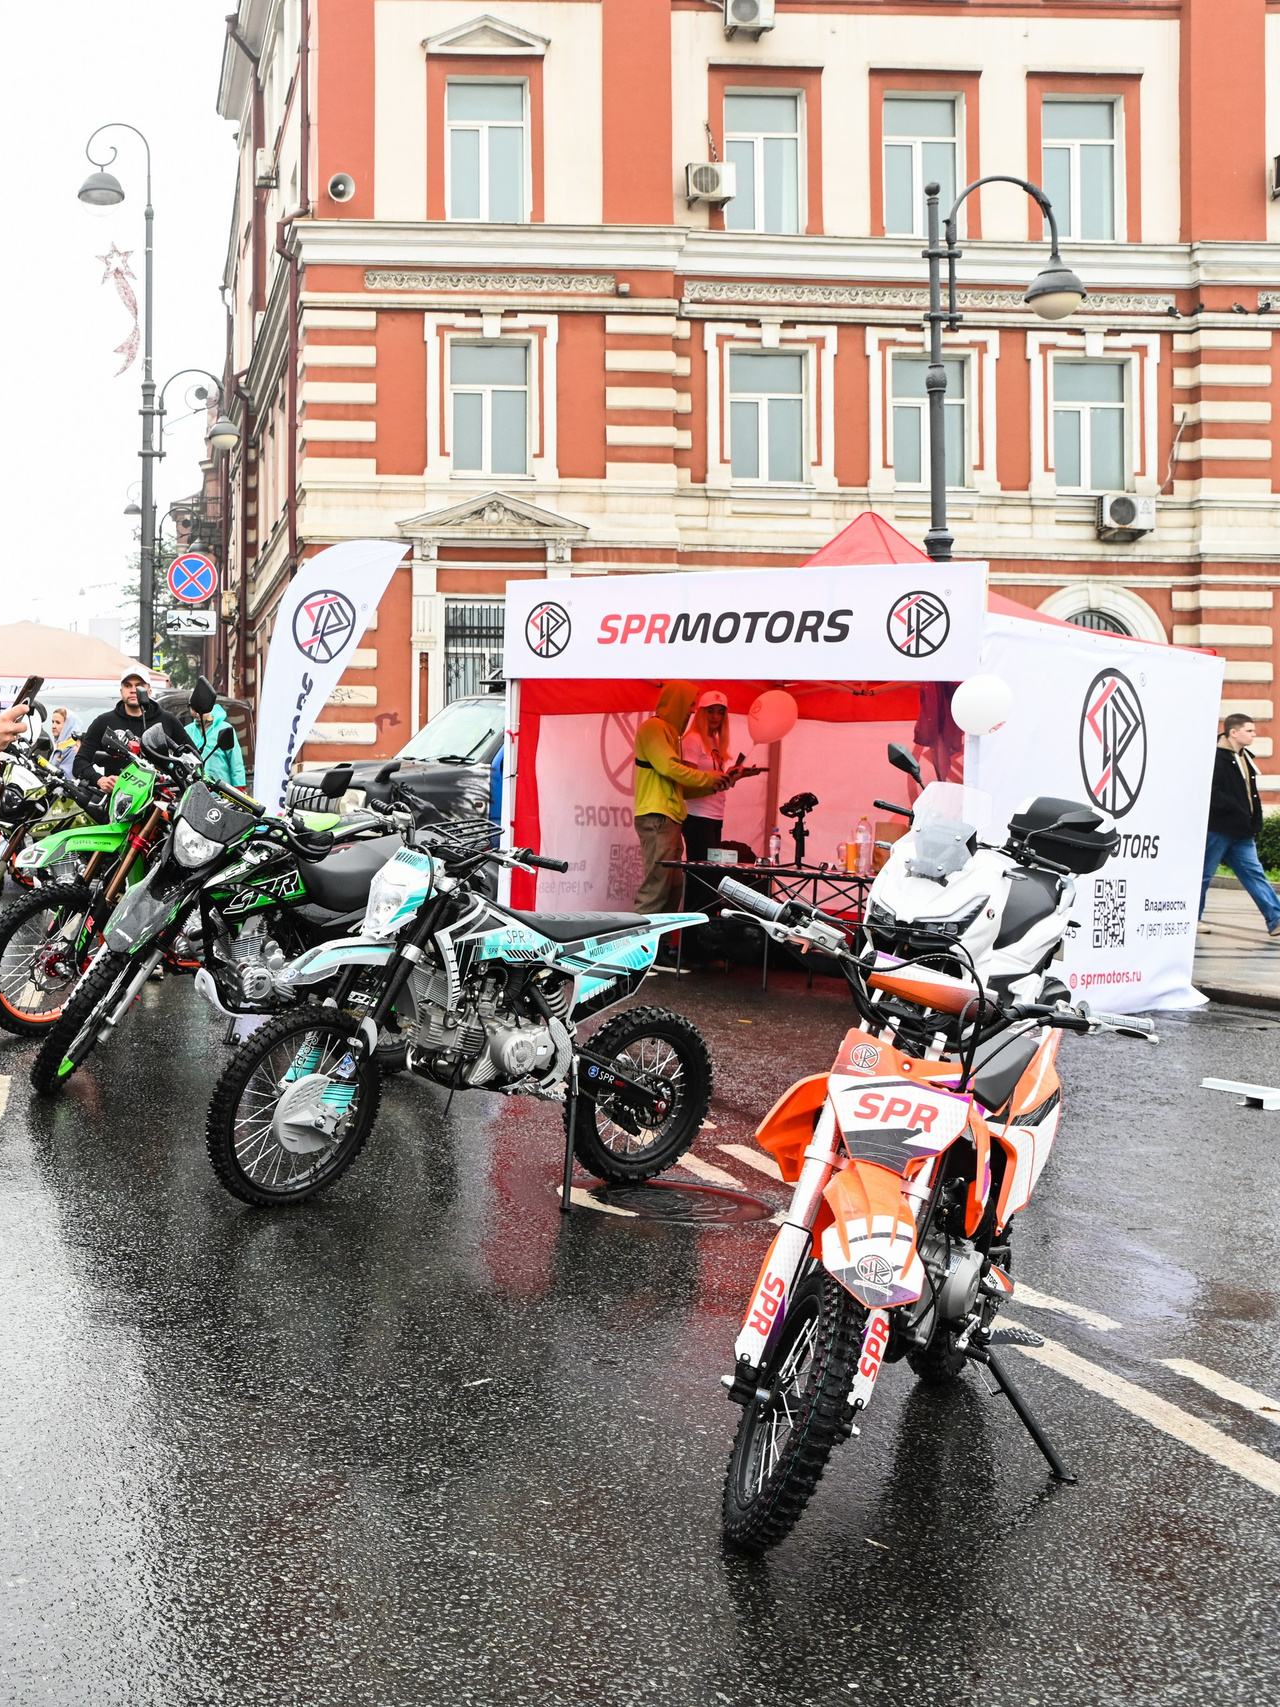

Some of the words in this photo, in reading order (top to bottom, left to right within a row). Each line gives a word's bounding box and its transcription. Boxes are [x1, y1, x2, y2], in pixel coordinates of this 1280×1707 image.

[596, 609, 854, 645] SPRMOTORS
[121, 771, 147, 789] SPR
[1144, 898, 1187, 913] Владивосток
[506, 930, 526, 944] SPR
[488, 947, 499, 955] SPR
[1080, 971, 1142, 989] sprmotors.ru
[599, 1071, 615, 1084] SPR
[853, 1092, 939, 1133] SPR
[749, 1272, 785, 1336] SPR
[860, 1317, 890, 1382] SPR
